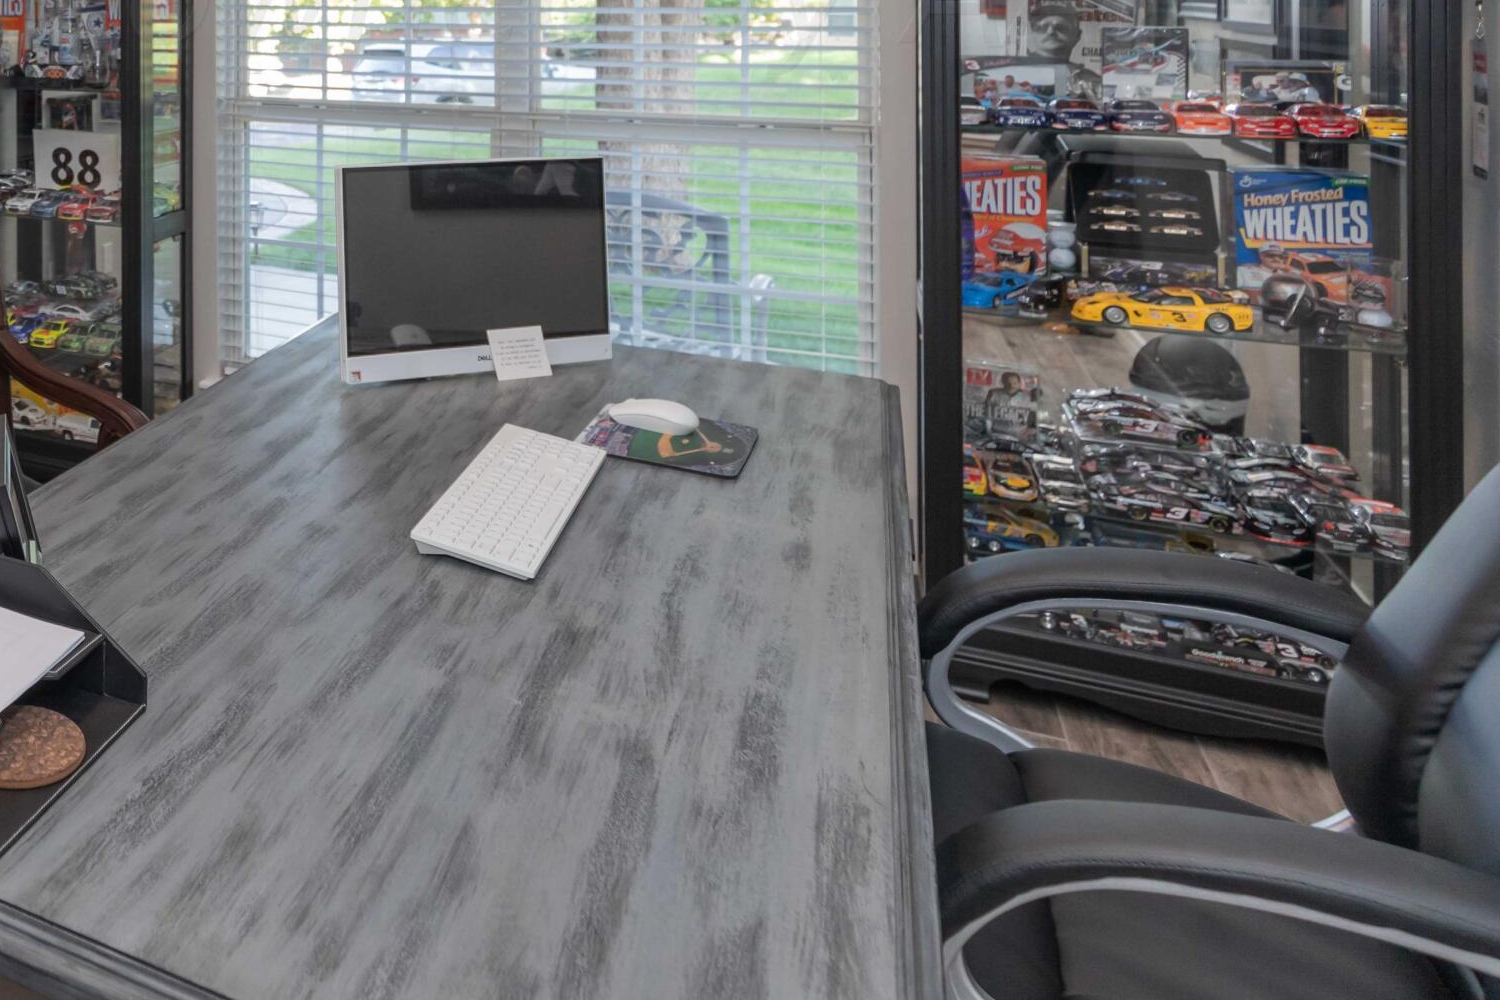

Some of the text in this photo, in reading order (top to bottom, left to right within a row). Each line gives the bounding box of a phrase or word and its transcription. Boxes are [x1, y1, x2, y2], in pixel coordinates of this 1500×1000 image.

[51, 147, 101, 189] 88
[1243, 186, 1344, 207] Honey Frosted
[1243, 200, 1369, 245] WHEATIES
[1172, 311, 1186, 323] 3
[987, 404, 1031, 425] LEGACY
[1166, 507, 1189, 520] 3
[1277, 643, 1299, 658] 3
